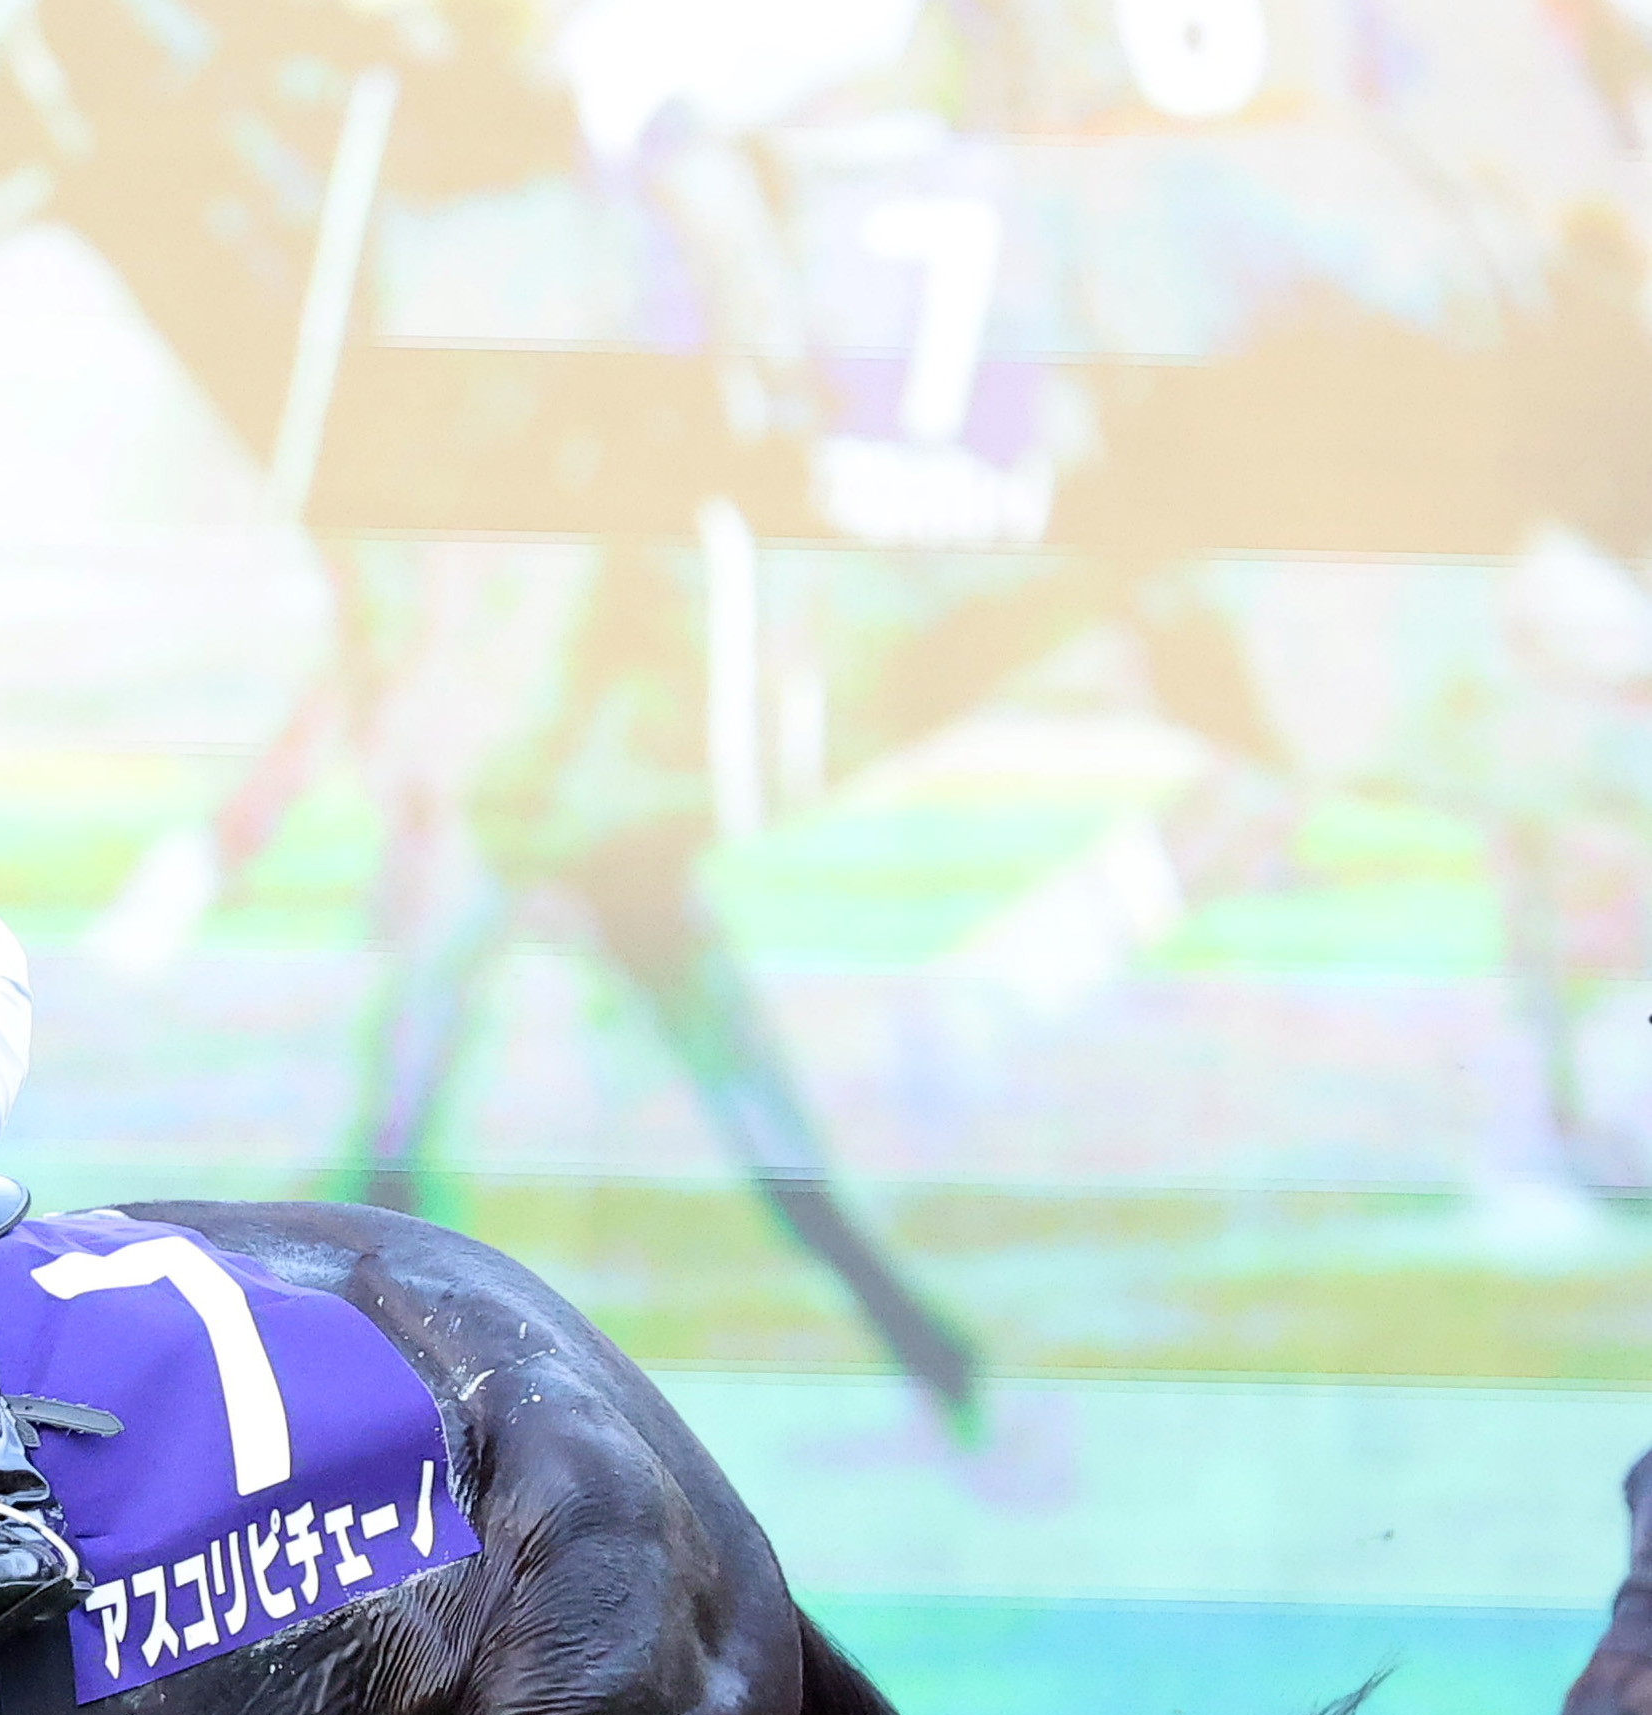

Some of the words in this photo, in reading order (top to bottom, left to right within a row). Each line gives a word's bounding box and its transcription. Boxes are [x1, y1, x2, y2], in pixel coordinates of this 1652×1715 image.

[861, 198, 1001, 440] 7
[31, 1236, 291, 1496] 7
[85, 1460, 435, 1680] アスコリピチェーノ
